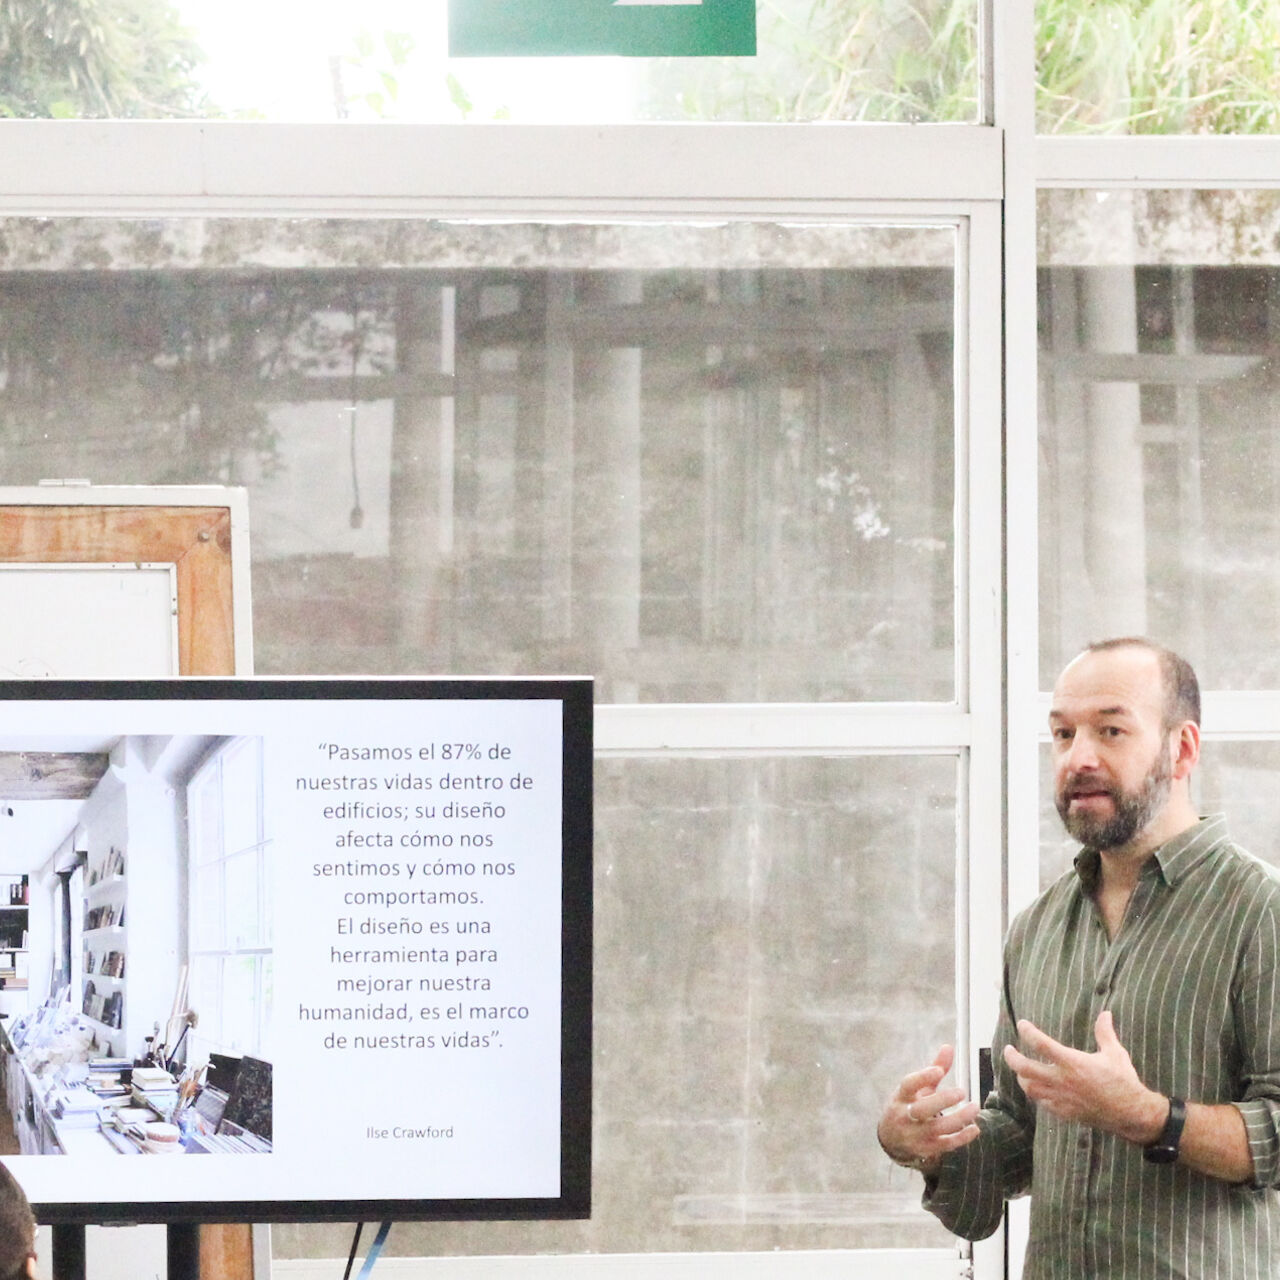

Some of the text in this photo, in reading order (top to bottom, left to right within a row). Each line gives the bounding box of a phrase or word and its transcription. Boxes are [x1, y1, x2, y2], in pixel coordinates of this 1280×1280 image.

[418, 742, 435, 761] el
[441, 742, 483, 761] 87%
[487, 742, 512, 761] de
[296, 771, 534, 791] nuestras vidas dentro de
[322, 800, 506, 822] edificios; su diseño
[335, 829, 494, 848] afecta cómo nos
[312, 857, 516, 880] sentimos y cómo nos
[343, 889, 484, 909] comportamos.
[337, 916, 491, 935] El diseño es una
[330, 945, 498, 967] herramienta para
[337, 975, 491, 996] mejorar nuestra
[299, 1001, 530, 1023] humanidad, es el marco
[323, 1031, 348, 1050] de
[354, 1033, 436, 1049] nuestras
[366, 1125, 454, 1139] Ilse Crawford
